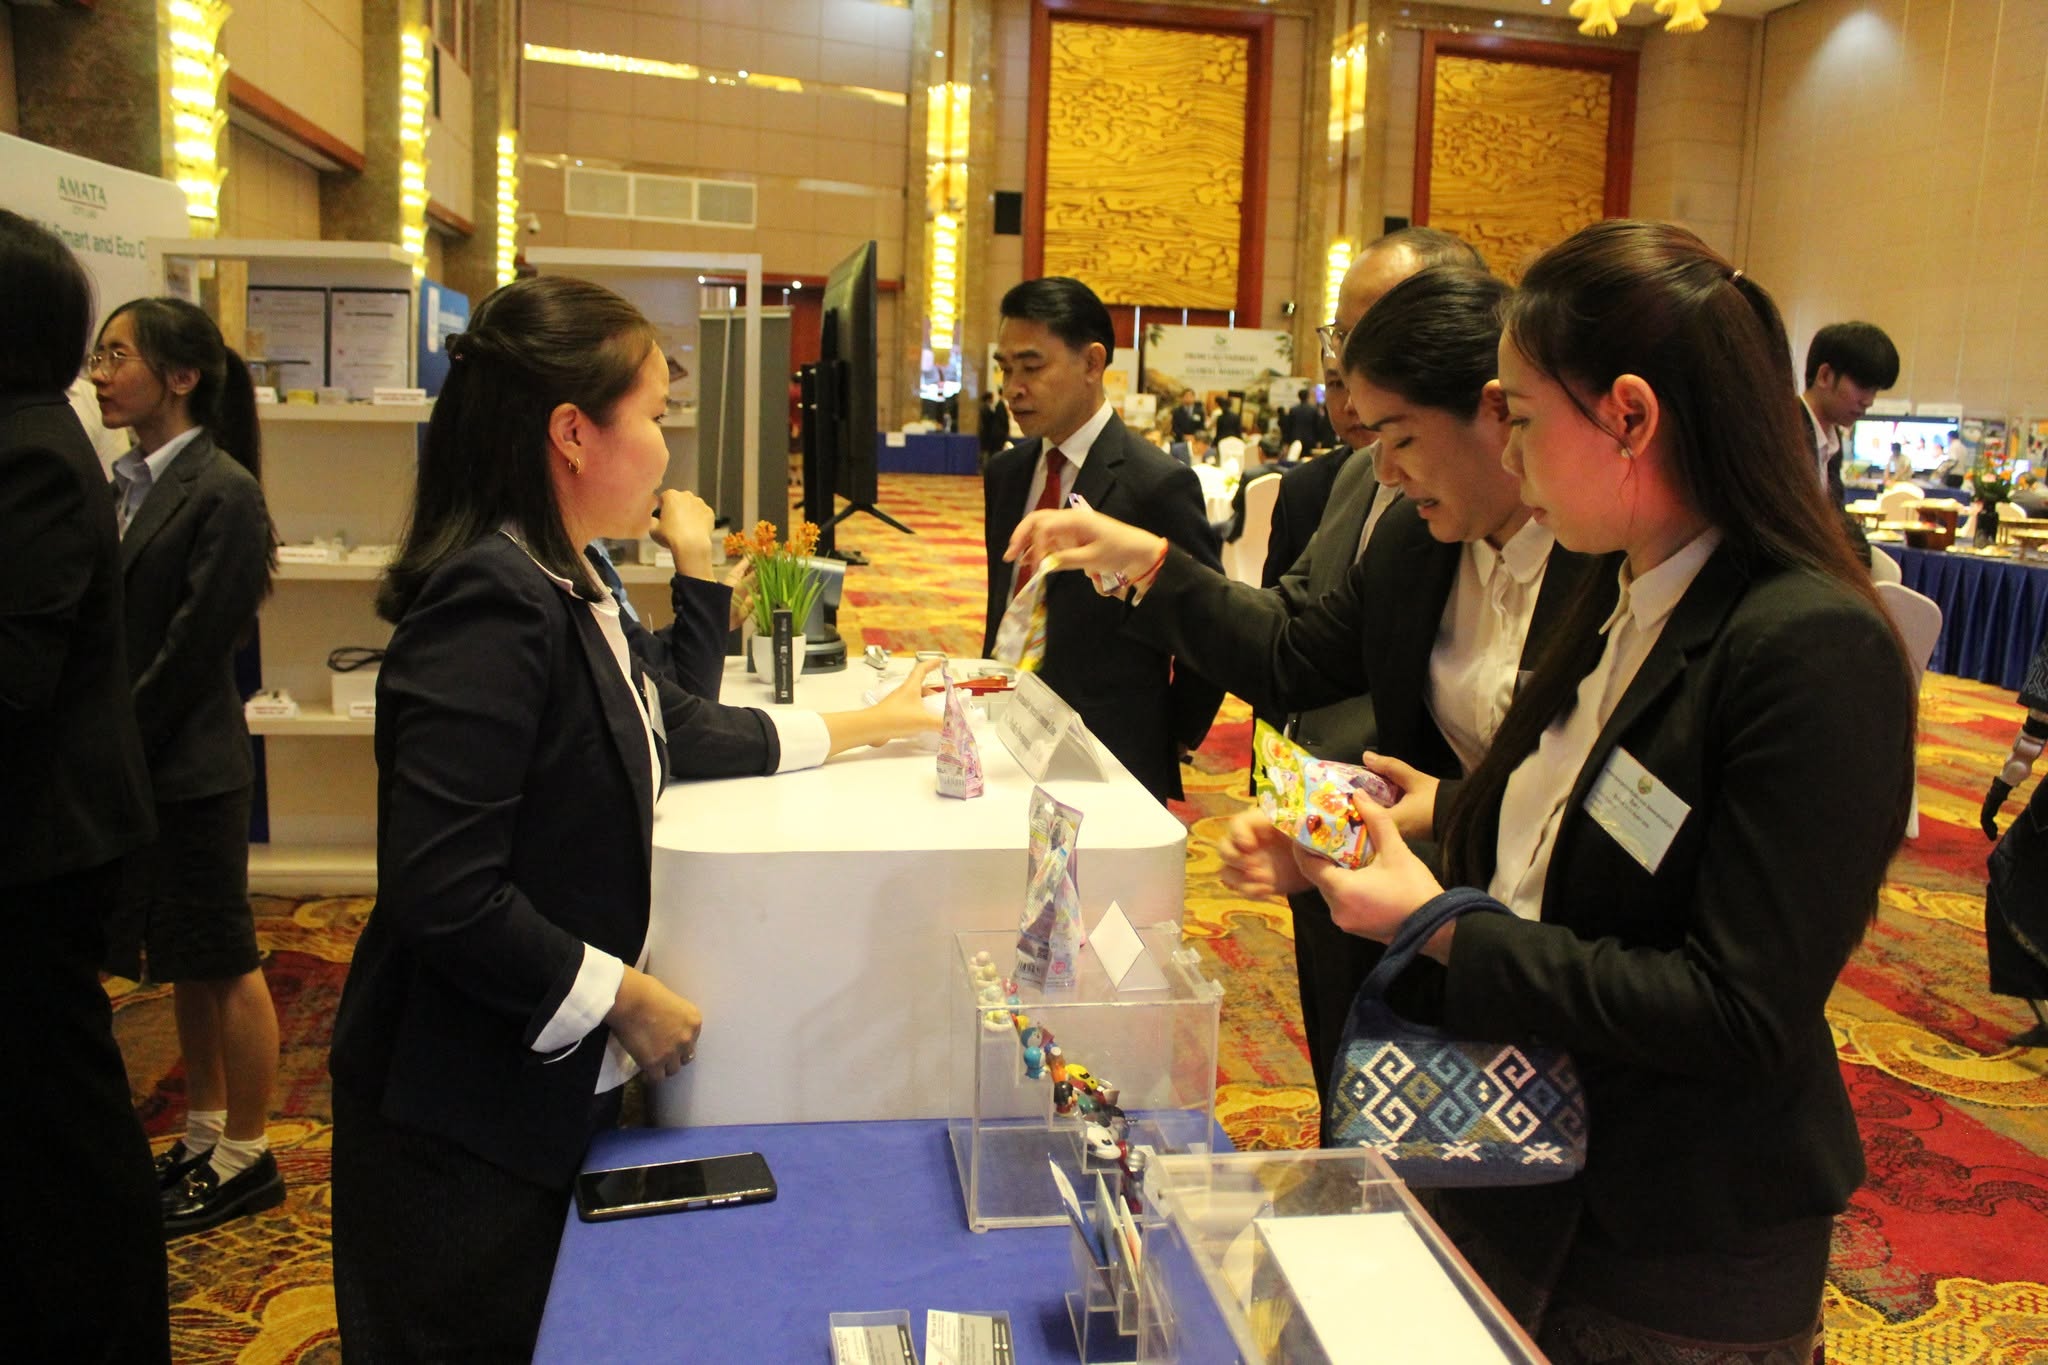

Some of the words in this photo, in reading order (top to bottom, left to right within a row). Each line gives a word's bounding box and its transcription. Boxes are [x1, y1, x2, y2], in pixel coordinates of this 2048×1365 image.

[57, 176, 107, 204] AMATA
[54, 223, 91, 251] Smart
[93, 234, 114, 255] and
[115, 234, 137, 258] Eco
